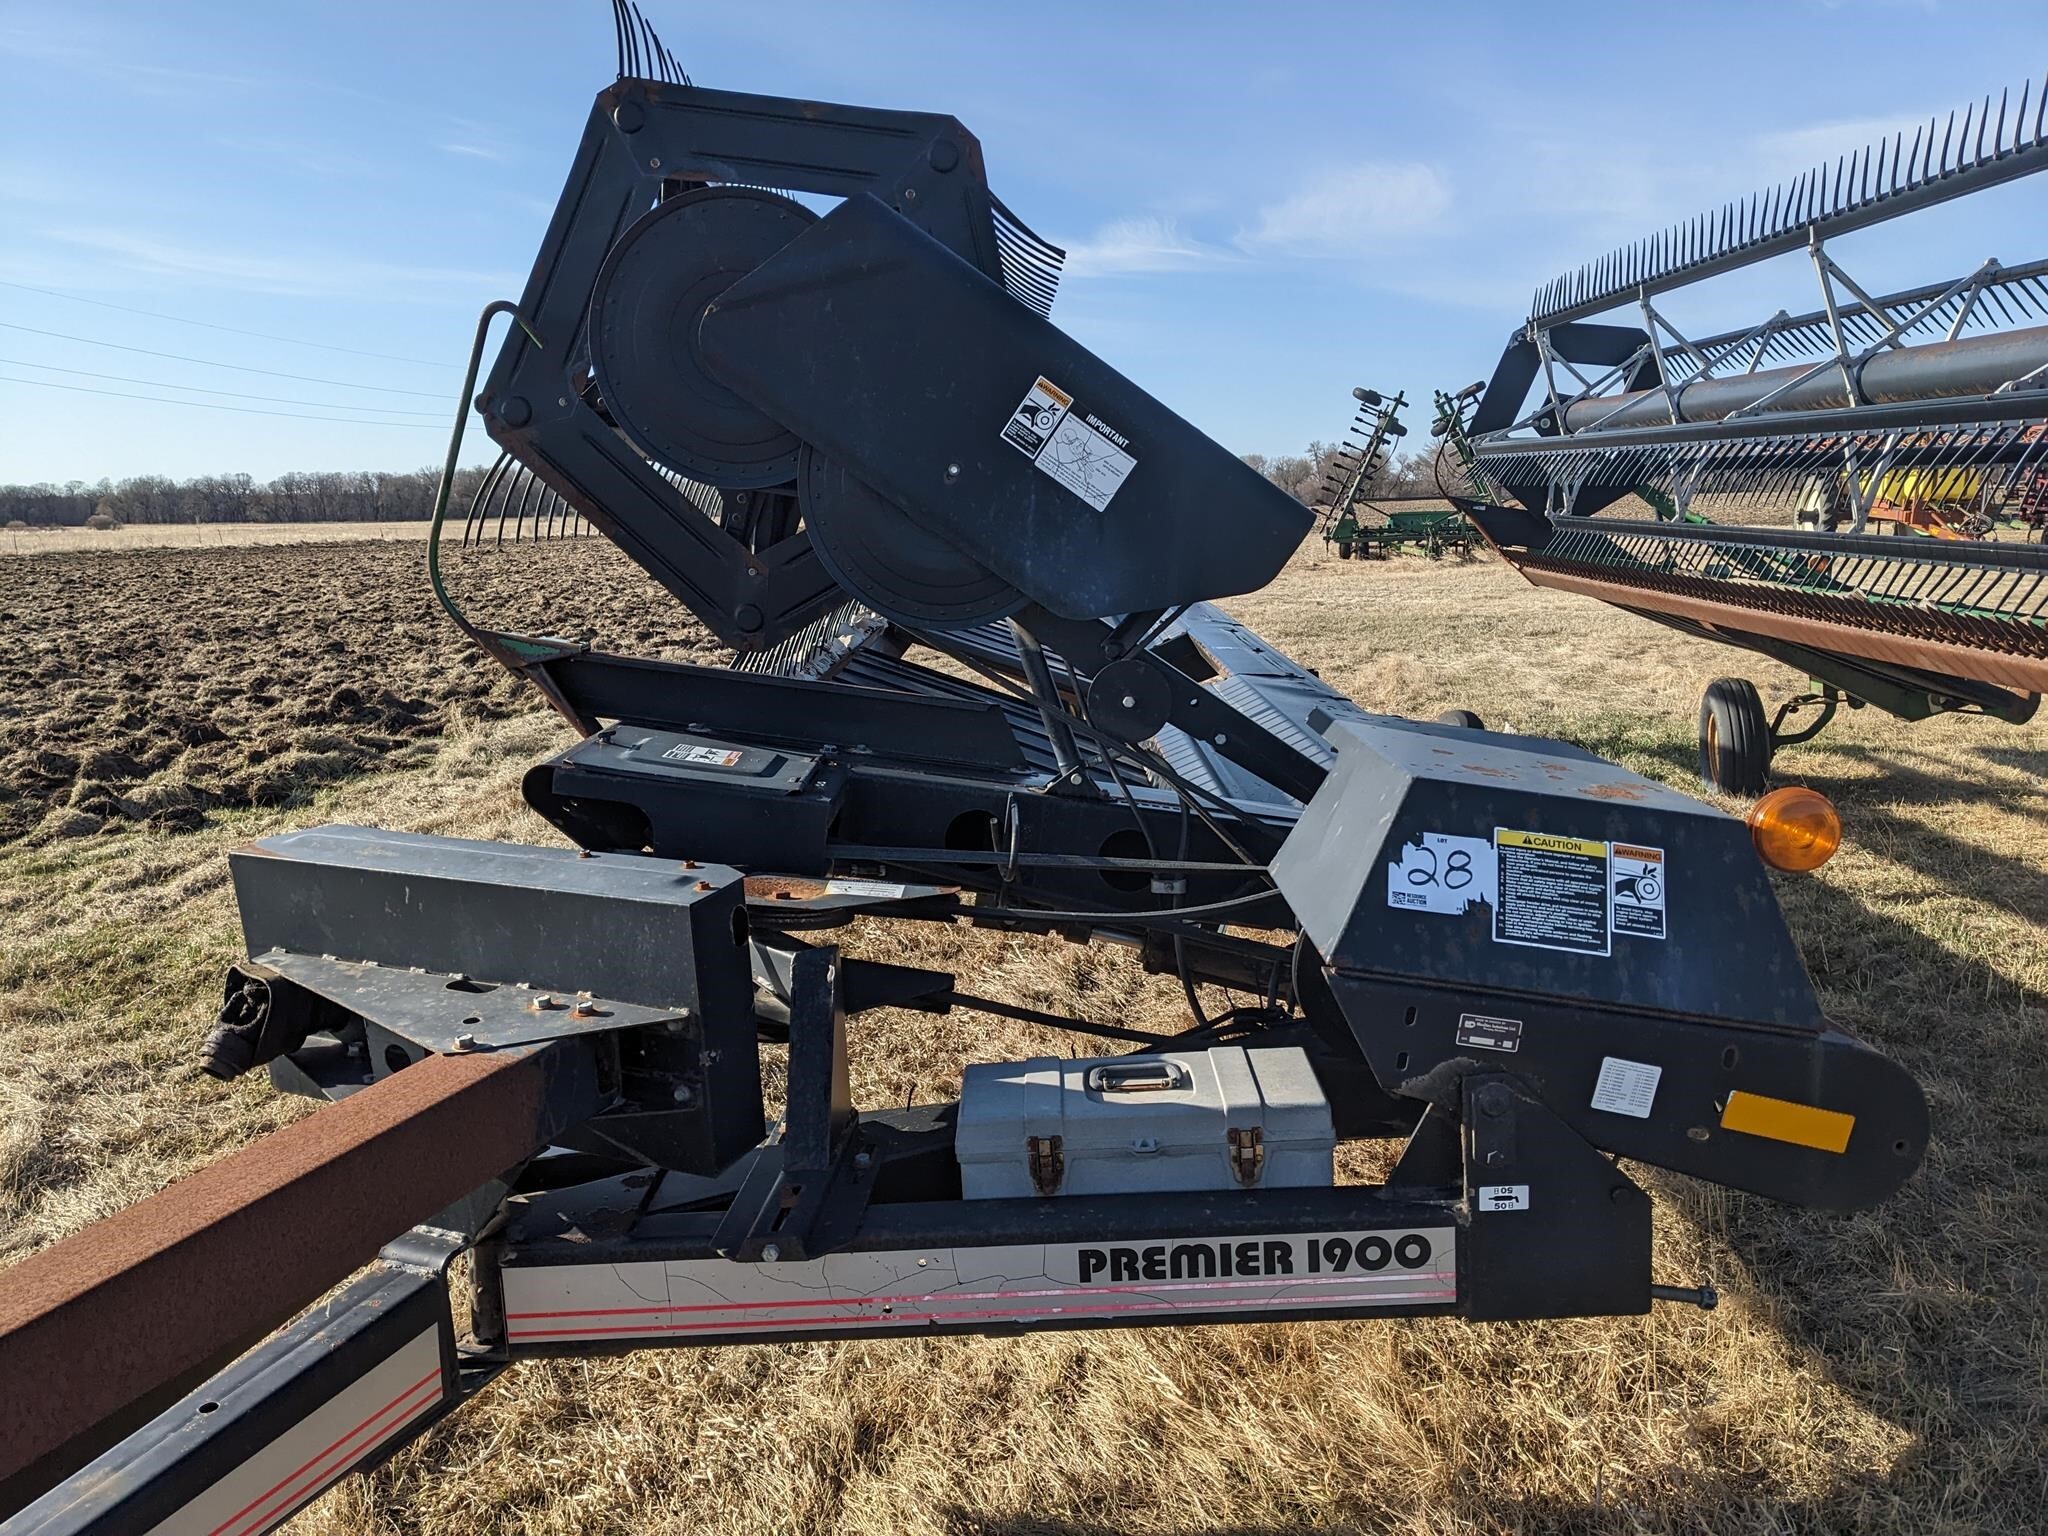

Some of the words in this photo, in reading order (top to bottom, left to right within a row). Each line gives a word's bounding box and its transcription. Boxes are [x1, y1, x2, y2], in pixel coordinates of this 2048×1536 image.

[1042, 382, 1070, 406] WARNING
[1085, 413, 1130, 449] IMPORTANT
[1533, 837, 1582, 852] CAUTION
[1621, 848, 1661, 861] WARNING
[1407, 846, 1473, 890] 28
[1494, 1202, 1507, 1210] 50
[1078, 1240, 1294, 1283] PREMIER
[1307, 1233, 1433, 1273] 1900
